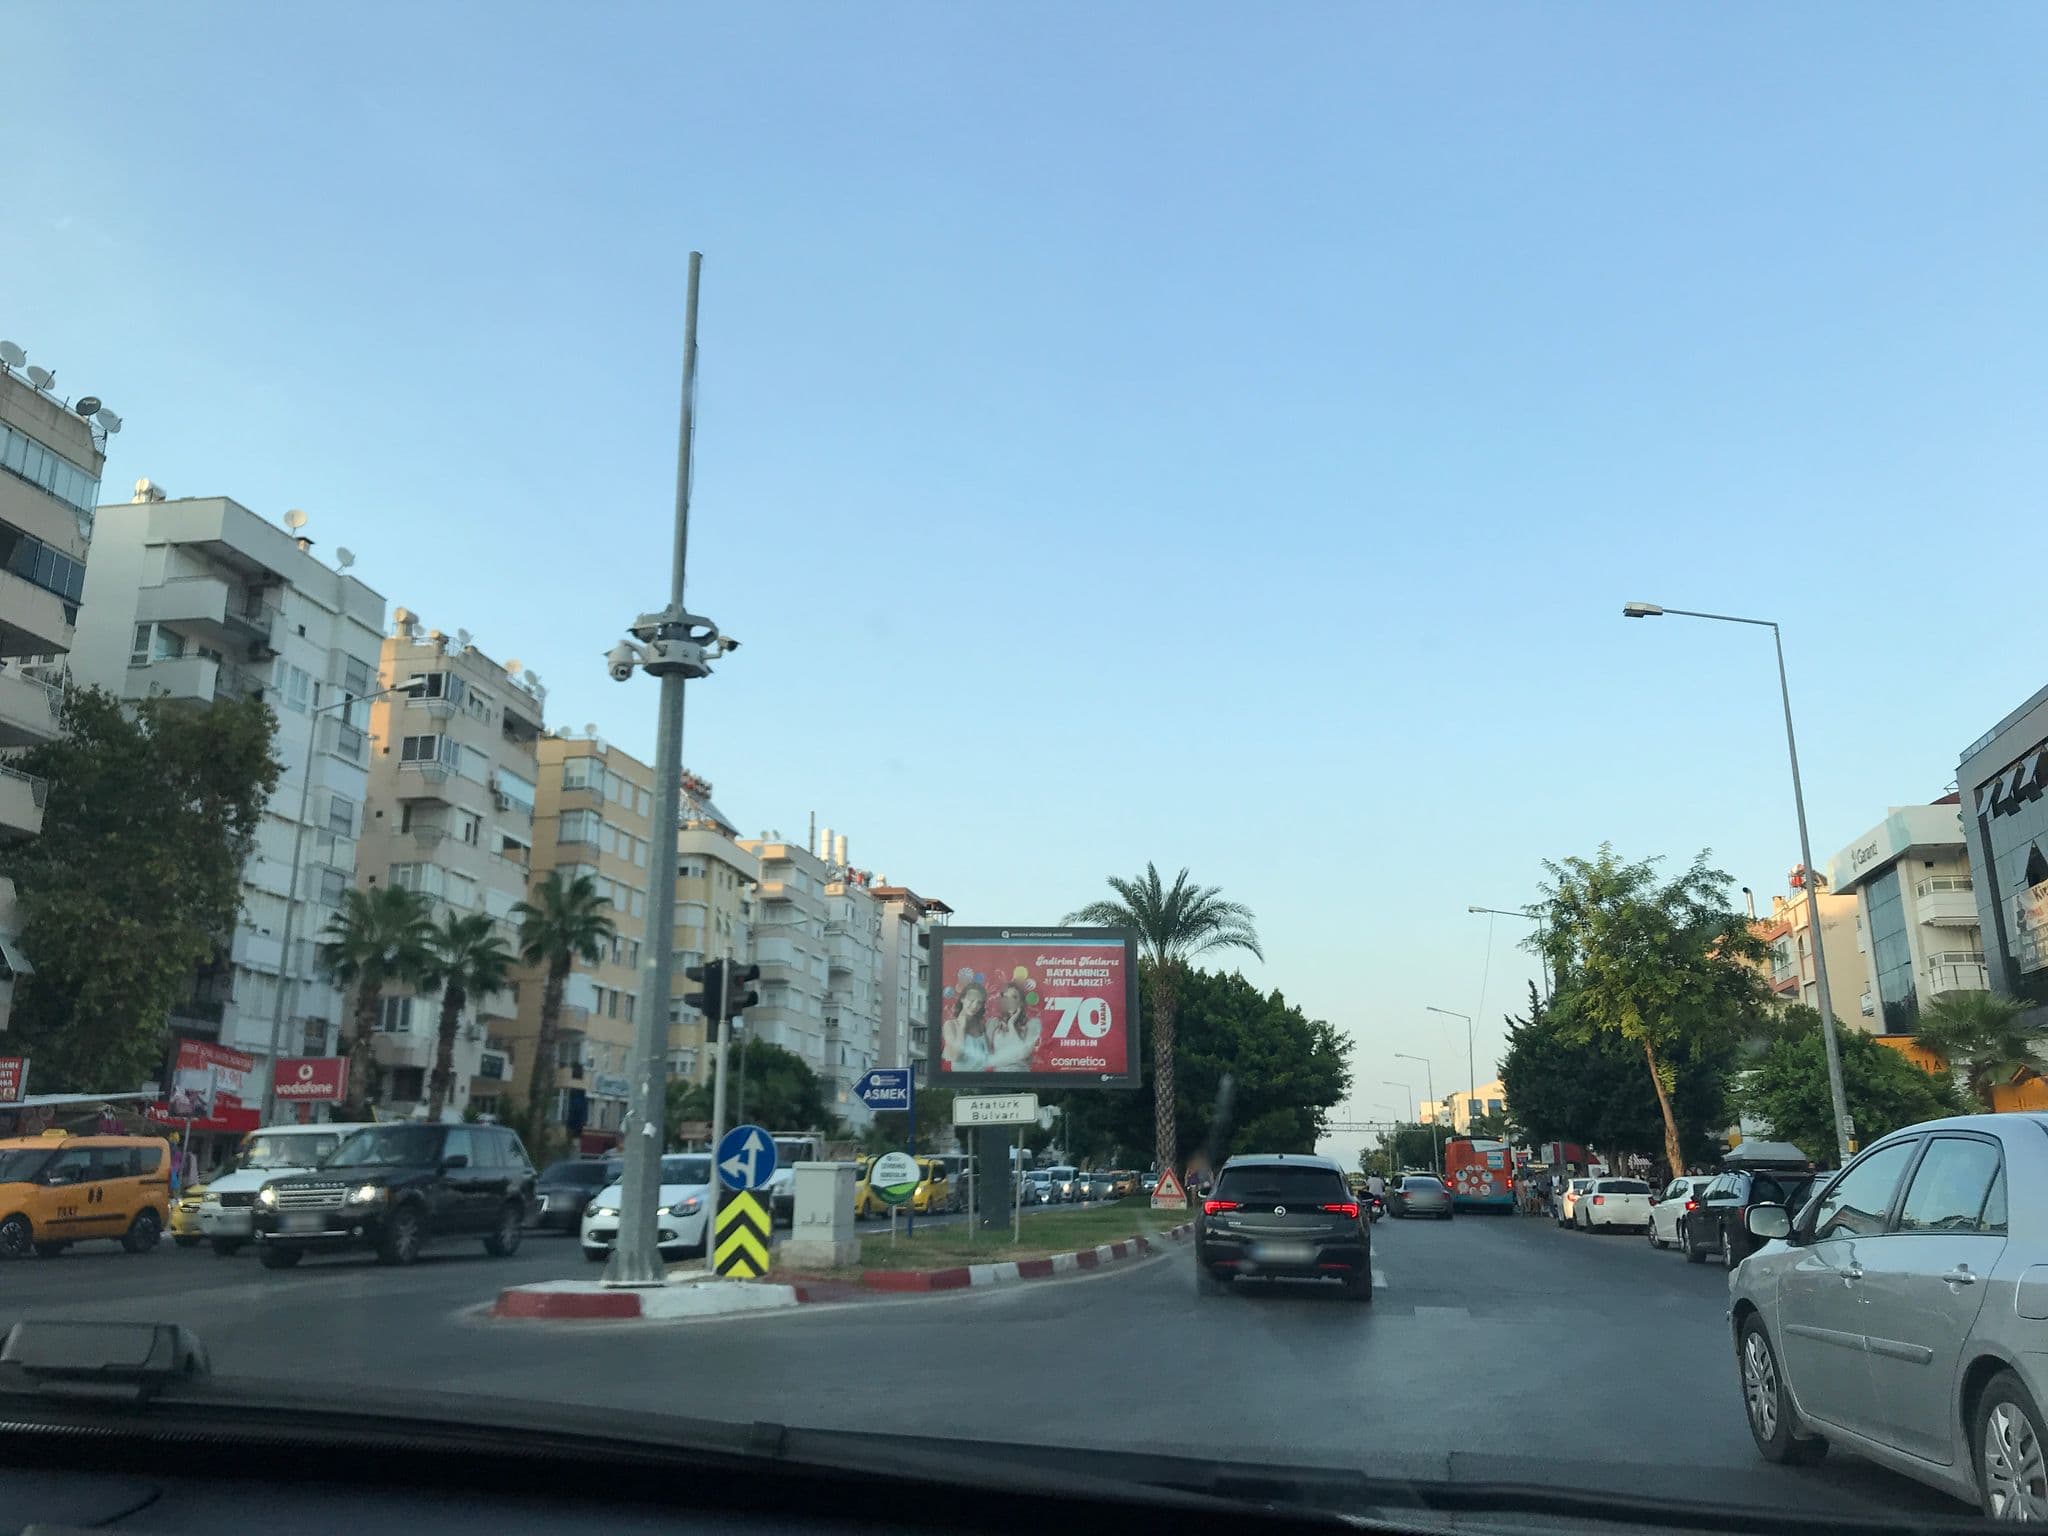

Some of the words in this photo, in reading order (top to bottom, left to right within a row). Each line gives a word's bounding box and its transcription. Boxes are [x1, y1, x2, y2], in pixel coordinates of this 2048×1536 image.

[1046, 969, 1110, 977] BAYRAMINIZI
[1051, 1056, 1106, 1067] cosmetica
[276, 1081, 333, 1095] vodafone
[863, 1088, 906, 1100] ASMEK
[972, 1111, 1019, 1121] Bulvarı
